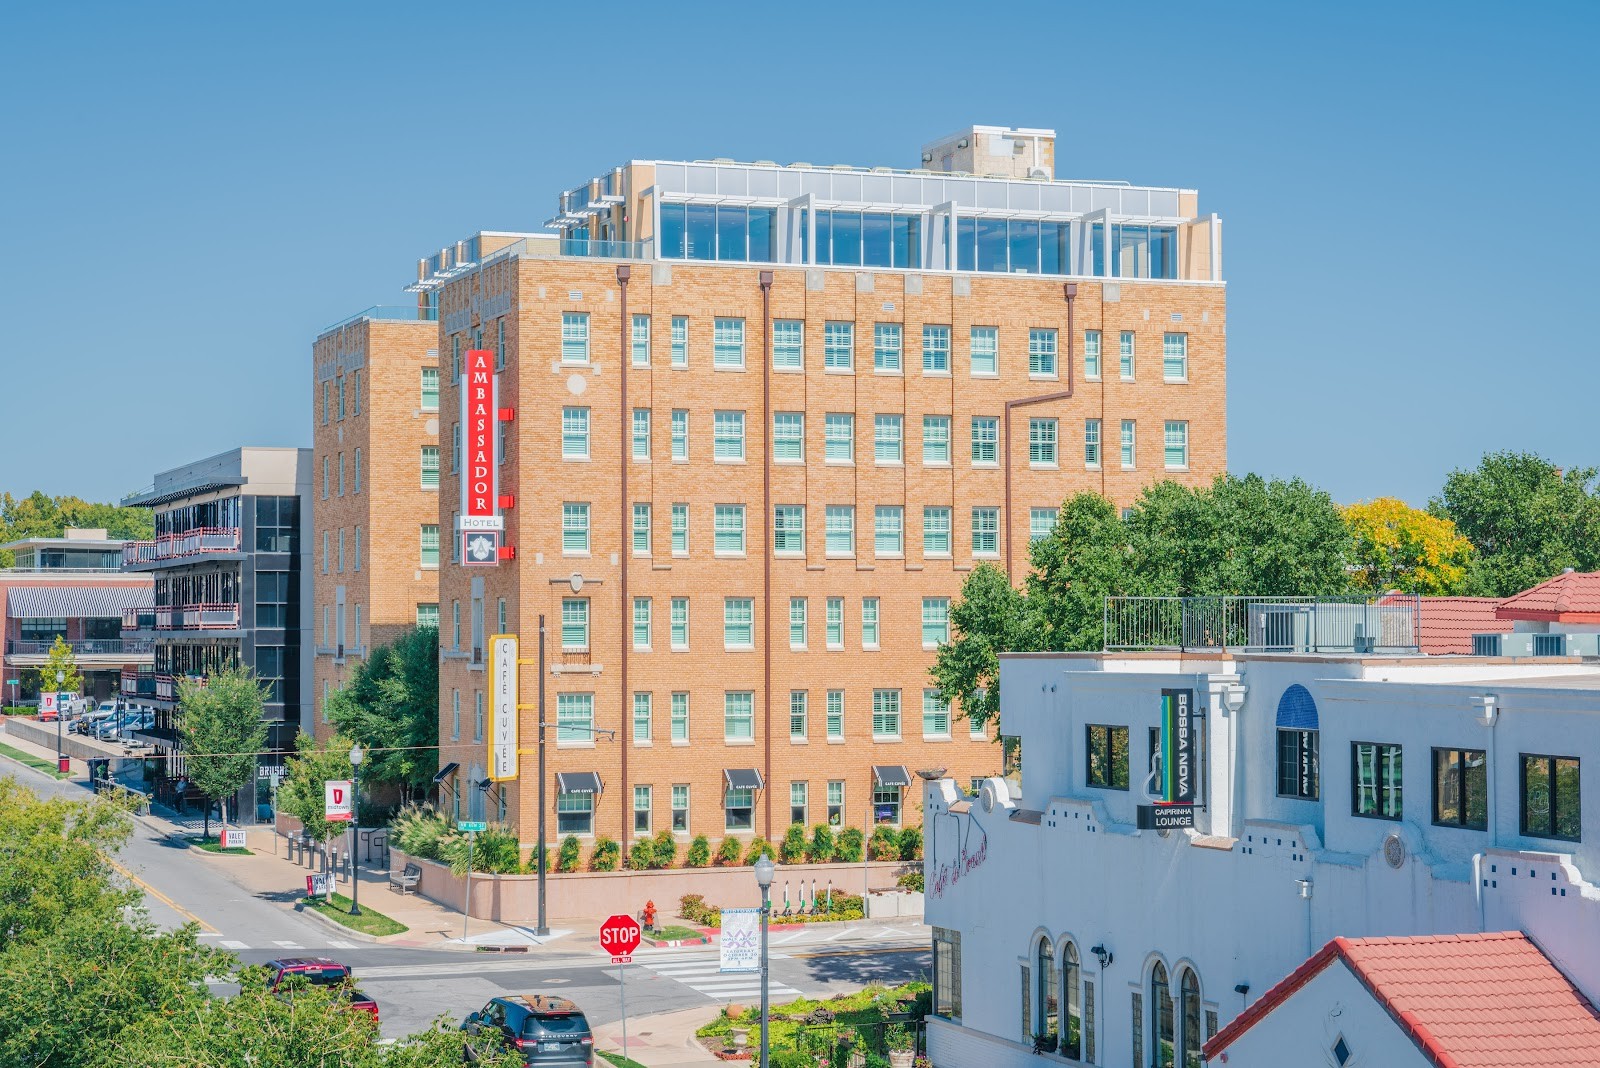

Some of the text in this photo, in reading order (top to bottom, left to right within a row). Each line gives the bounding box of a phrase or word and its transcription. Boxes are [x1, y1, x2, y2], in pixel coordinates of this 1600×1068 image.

[473, 356, 488, 510] AMBASSADOR
[1178, 693, 1188, 798] BOSSA NOVA
[1154, 808, 1192, 816] CAIPIRINHA
[1155, 817, 1192, 826] LOUNGE
[228, 832, 244, 840] VALET
[314, 876, 332, 885] VALT
[602, 926, 639, 945] STOP
